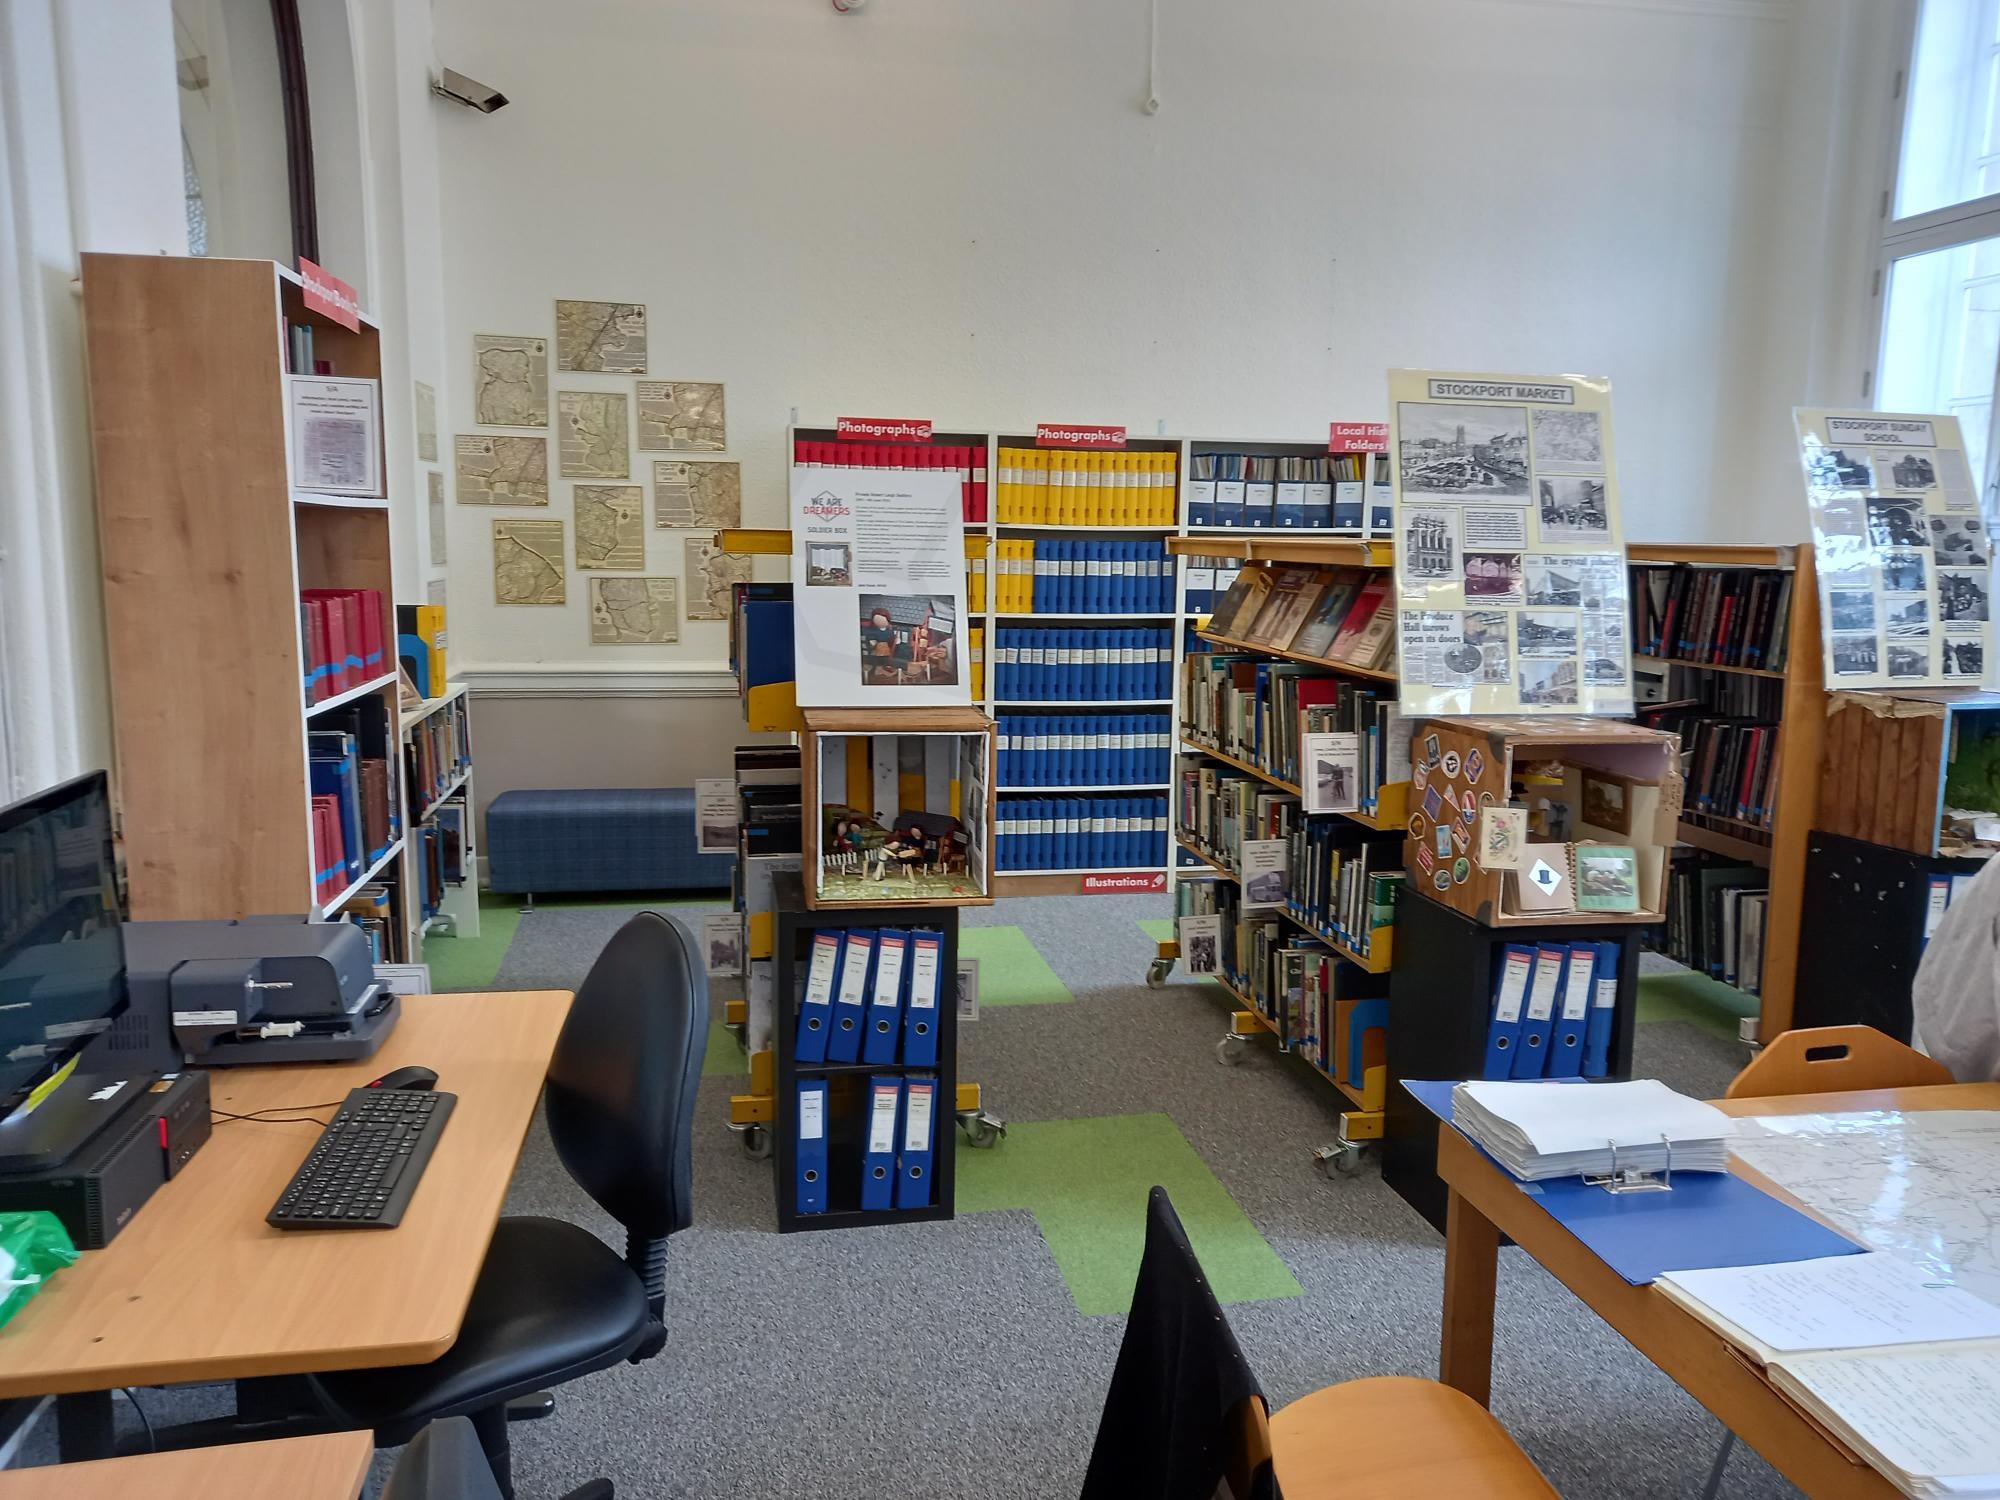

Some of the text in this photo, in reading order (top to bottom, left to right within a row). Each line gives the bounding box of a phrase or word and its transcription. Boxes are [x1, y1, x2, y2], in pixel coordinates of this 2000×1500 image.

[1436, 383, 1567, 400] STOCKPORT MARKET
[838, 421, 916, 436] Photographs
[1336, 425, 1388, 436] Local Hist
[1831, 420, 1927, 432] STOCKPORT SUNDAY
[1038, 428, 1111, 443] Photographs
[1863, 433, 1903, 443] SCHOOL
[1344, 439, 1385, 450] Folders
[810, 498, 843, 506] WE ARE
[803, 506, 850, 515] DREAMERS
[807, 526, 833, 534] SOLDIER
[1403, 611, 1418, 620] The
[1438, 634, 1461, 642] doors
[1085, 876, 1149, 888] Illustrations
